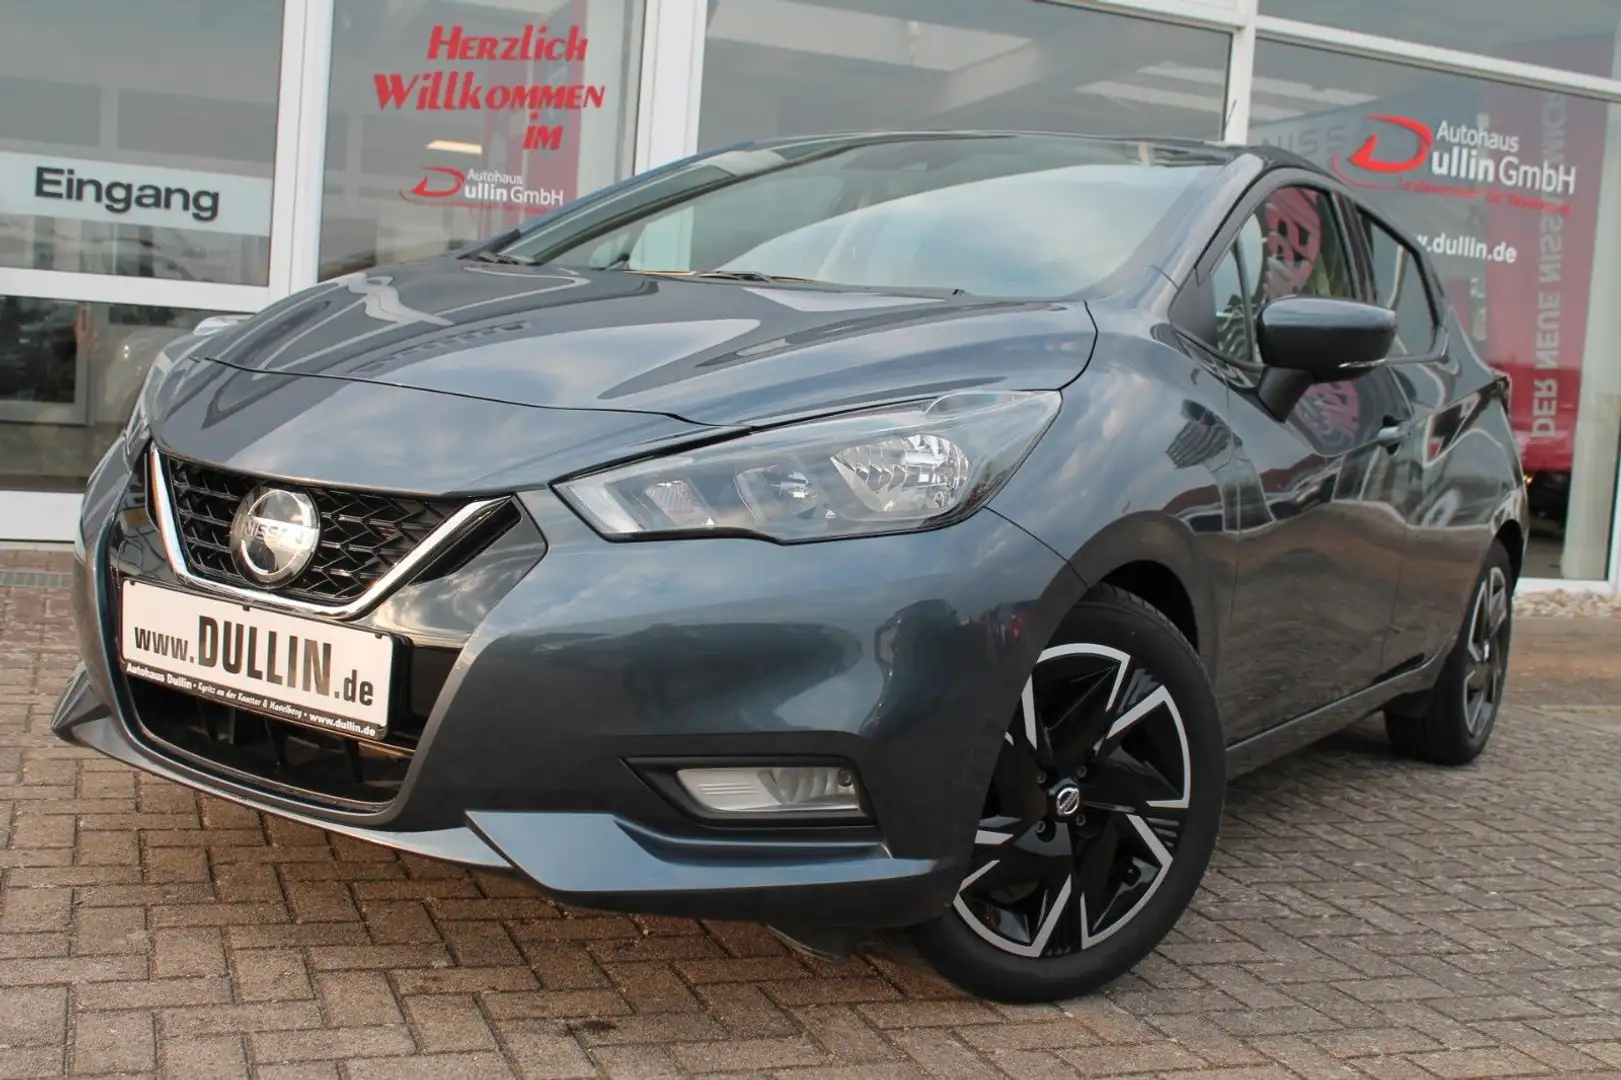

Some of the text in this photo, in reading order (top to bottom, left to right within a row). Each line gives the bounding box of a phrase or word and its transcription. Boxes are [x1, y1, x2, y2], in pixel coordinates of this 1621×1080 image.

[1436, 120, 1519, 153] Autohaus
[467, 169, 523, 184] Autohaus
[1499, 155, 1576, 195] GmbH
[35, 166, 219, 222] Eingang
[510, 186, 564, 206] GmbH
[126, 662, 165, 682] Autohaus
[166, 673, 193, 690] Dullin
[309, 713, 376, 737] www.dullin.de
